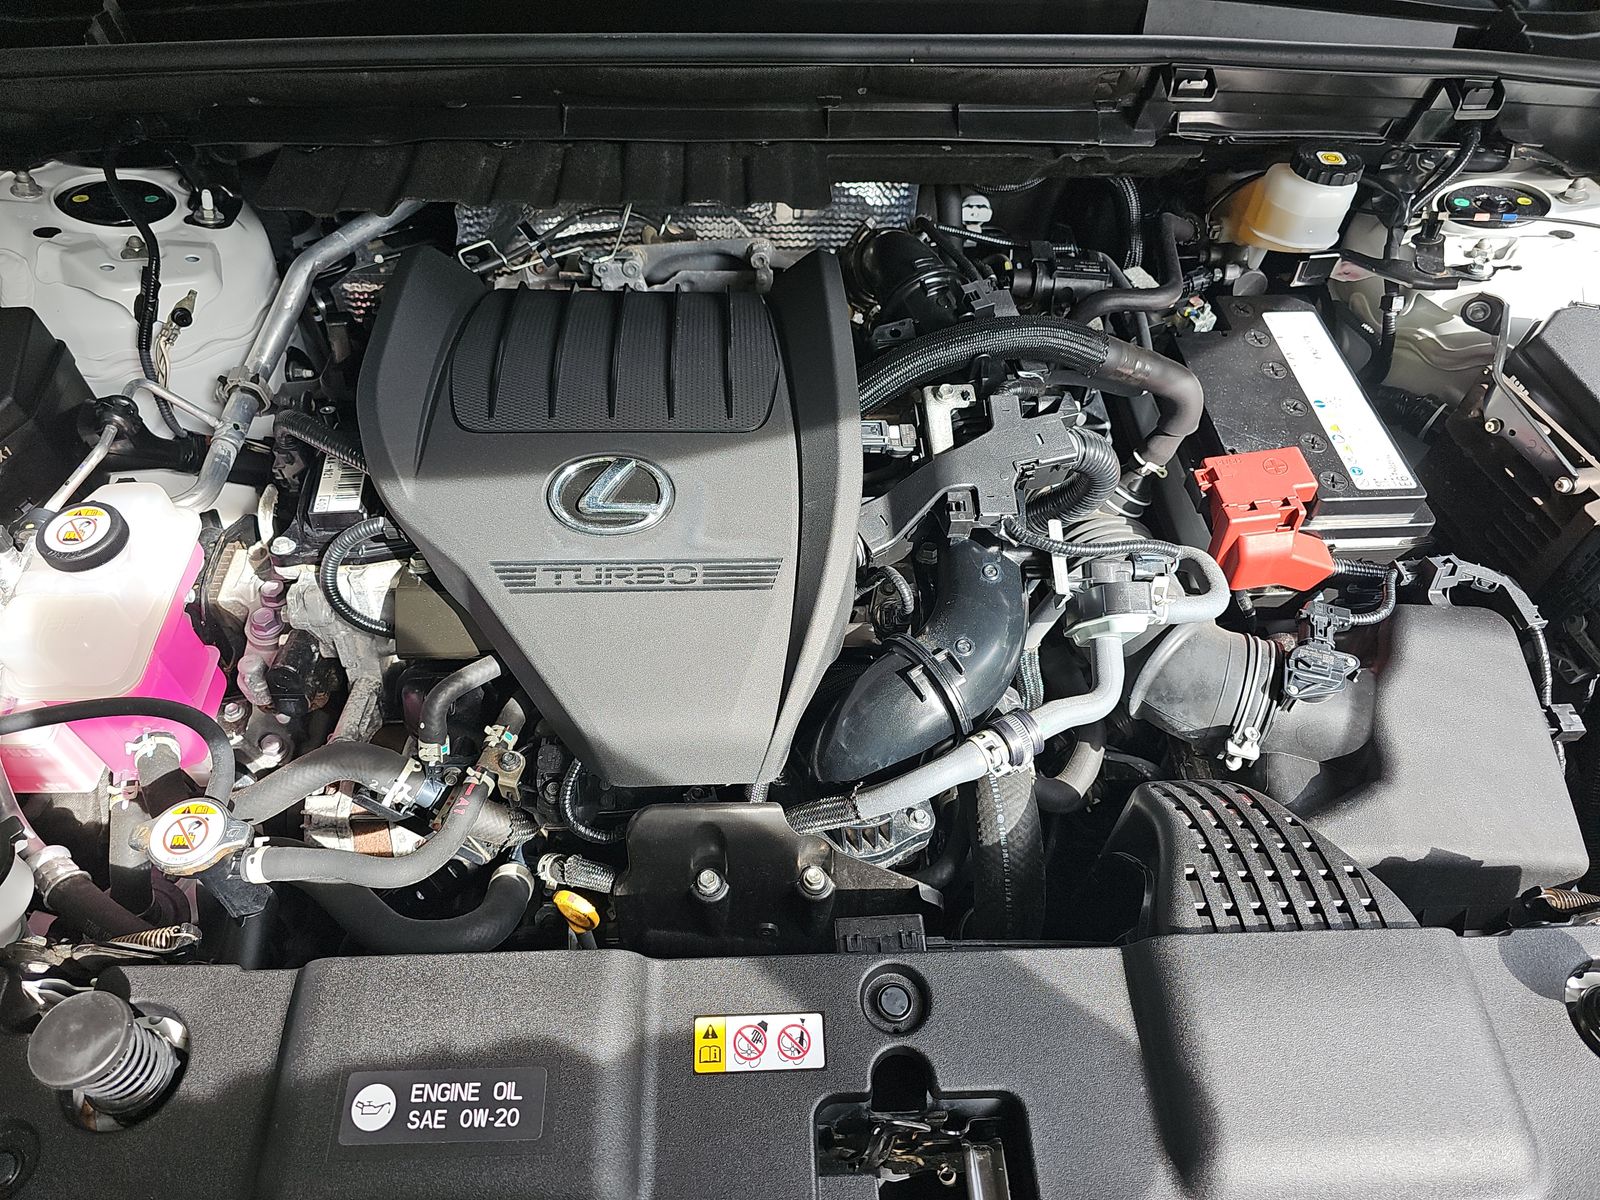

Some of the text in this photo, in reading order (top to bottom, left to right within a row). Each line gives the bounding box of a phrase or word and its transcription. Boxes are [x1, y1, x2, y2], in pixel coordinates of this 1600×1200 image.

[540, 564, 698, 586] TURBO
[410, 1081, 523, 1103] ENGINE OIL
[406, 1107, 521, 1130] SAE 0W-20
